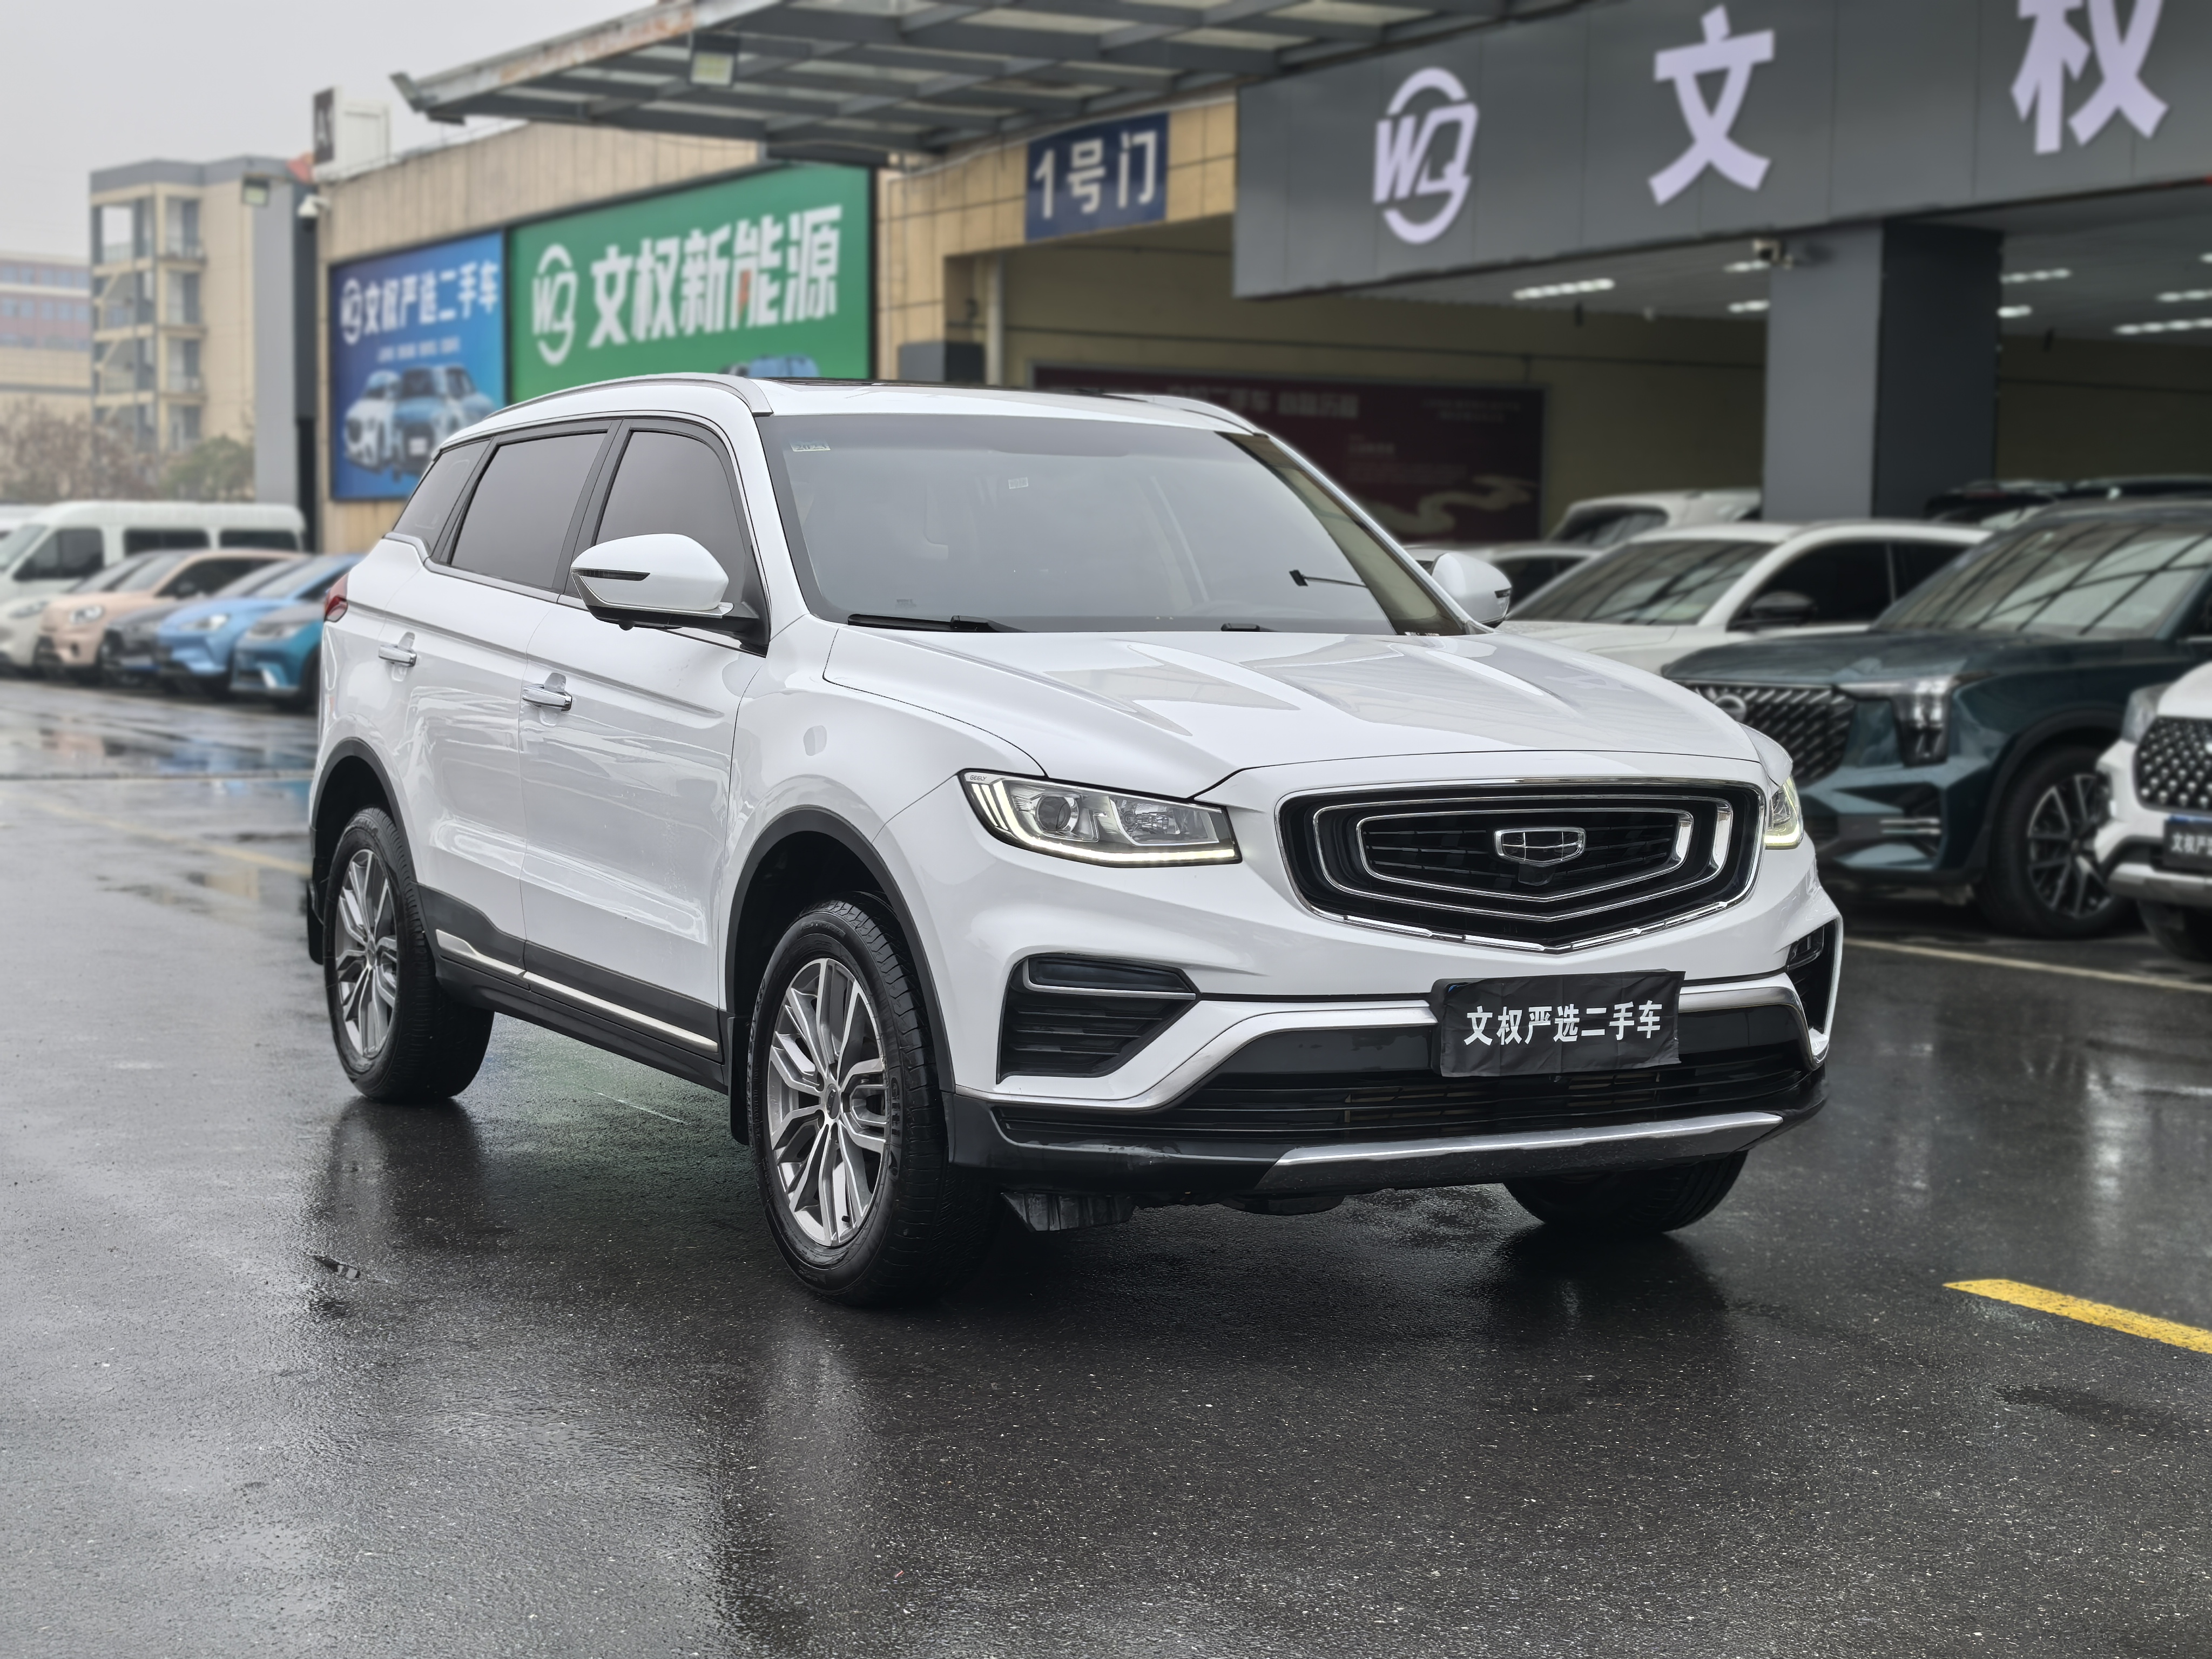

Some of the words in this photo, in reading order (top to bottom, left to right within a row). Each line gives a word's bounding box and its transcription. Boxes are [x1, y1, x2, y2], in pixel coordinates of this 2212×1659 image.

[1034, 130, 1157, 219] 1号门
[364, 260, 498, 335] 文权严选二手车
[588, 204, 842, 349] 文权新能源
[1463, 1000, 1663, 1046] 文权严选二手车
